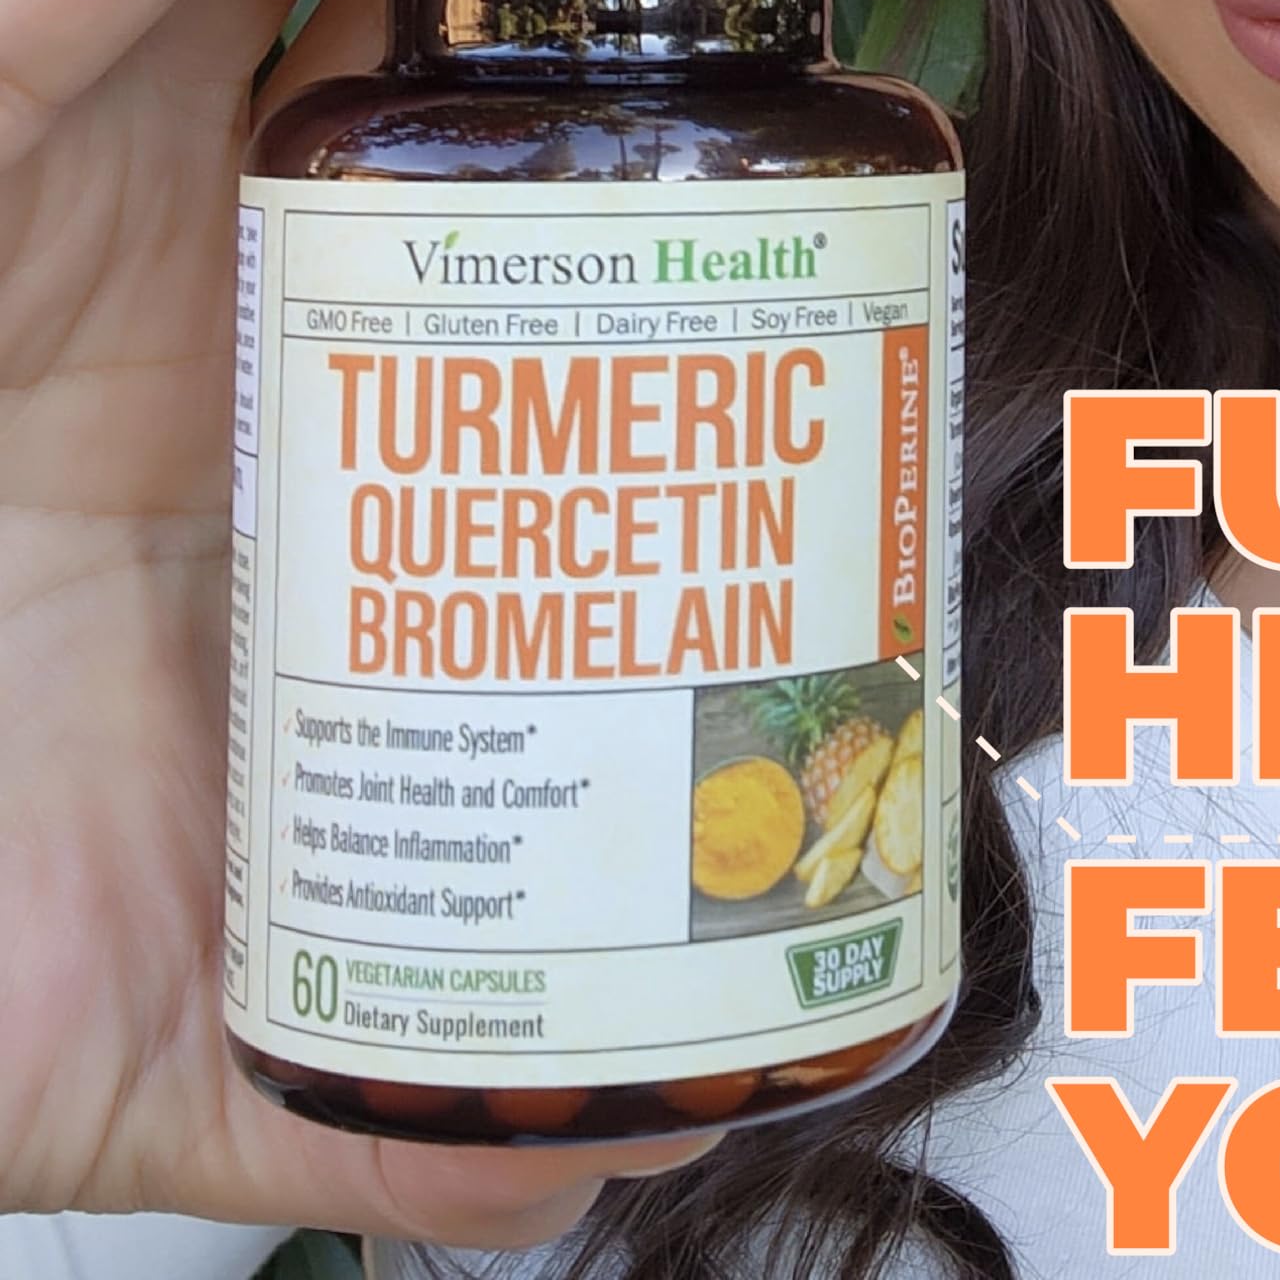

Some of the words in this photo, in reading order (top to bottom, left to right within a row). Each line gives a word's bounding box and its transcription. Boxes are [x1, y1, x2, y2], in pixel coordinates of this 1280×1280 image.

[402, 230, 639, 286] Vimerson
[306, 308, 347, 332] GMO
[352, 310, 393, 334] Free
[424, 313, 498, 336] Gluten
[506, 313, 559, 336] Free
[597, 313, 660, 339] Dairy
[666, 311, 718, 333] Free
[751, 308, 791, 333] Soy
[795, 306, 838, 328] Free
[864, 301, 909, 327] Vegan
[328, 348, 826, 476] TURMERIC
[350, 477, 795, 584] QUERCETIN
[350, 580, 793, 680] BROMELAIN
[294, 708, 352, 748] Supports
[357, 717, 380, 748] the
[386, 719, 452, 752] Immune
[294, 762, 354, 799] Promotes
[357, 771, 395, 804] Joint
[400, 774, 455, 807] Health
[461, 778, 495, 808] and
[293, 815, 327, 855] Helps
[331, 822, 389, 858] Balance
[292, 868, 343, 908] Provides
[346, 879, 436, 917] Antioxidant
[813, 947, 840, 971] 30
[845, 935, 884, 965] DAY
[292, 948, 338, 1023] 60
[345, 959, 445, 992] VEGETARIAN
[450, 968, 546, 994] CAPSULES
[813, 958, 884, 996] SUPPLY
[344, 1000, 409, 1037] Dietary
[417, 1008, 545, 1041] Supplement
